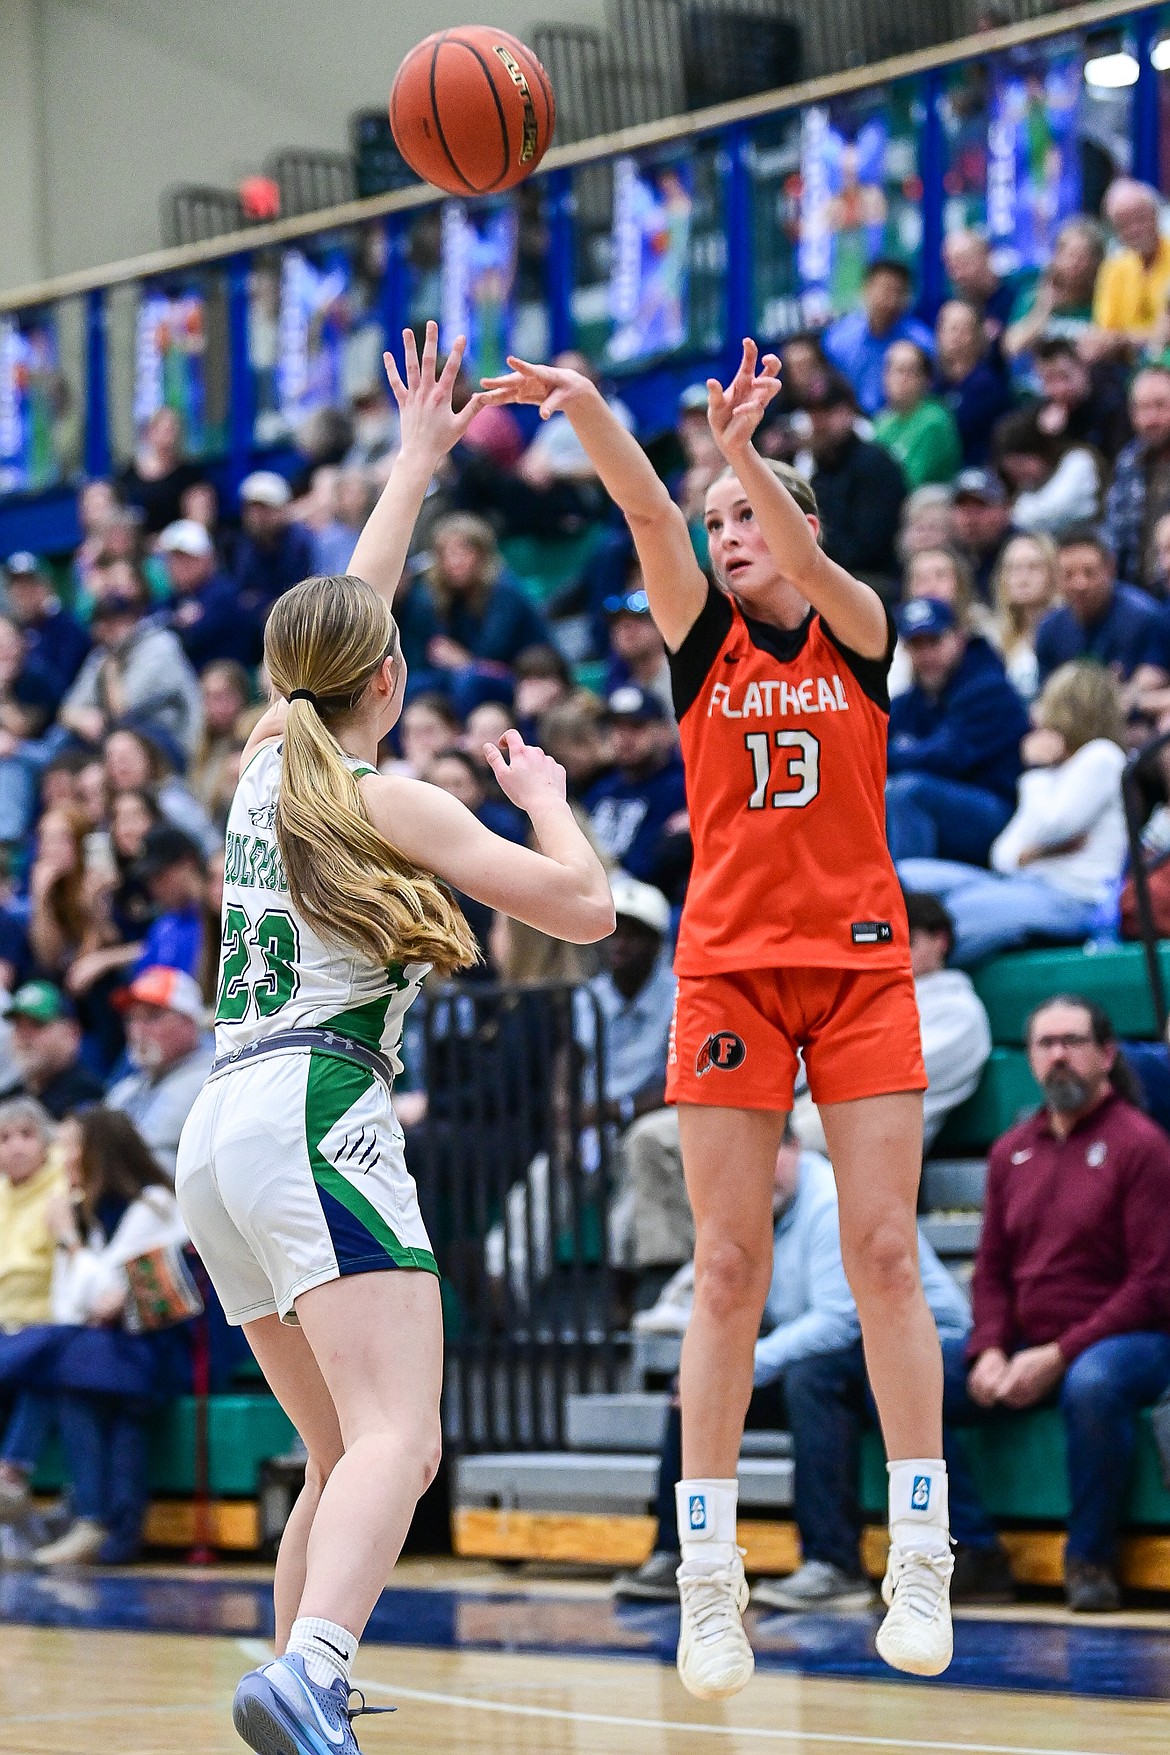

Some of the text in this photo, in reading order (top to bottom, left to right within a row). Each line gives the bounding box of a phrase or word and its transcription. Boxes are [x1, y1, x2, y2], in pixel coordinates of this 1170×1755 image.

[493, 45, 536, 122] ELITE
[744, 728, 821, 810] 13
[214, 902, 301, 1027] 23
[717, 1037, 737, 1064] F
